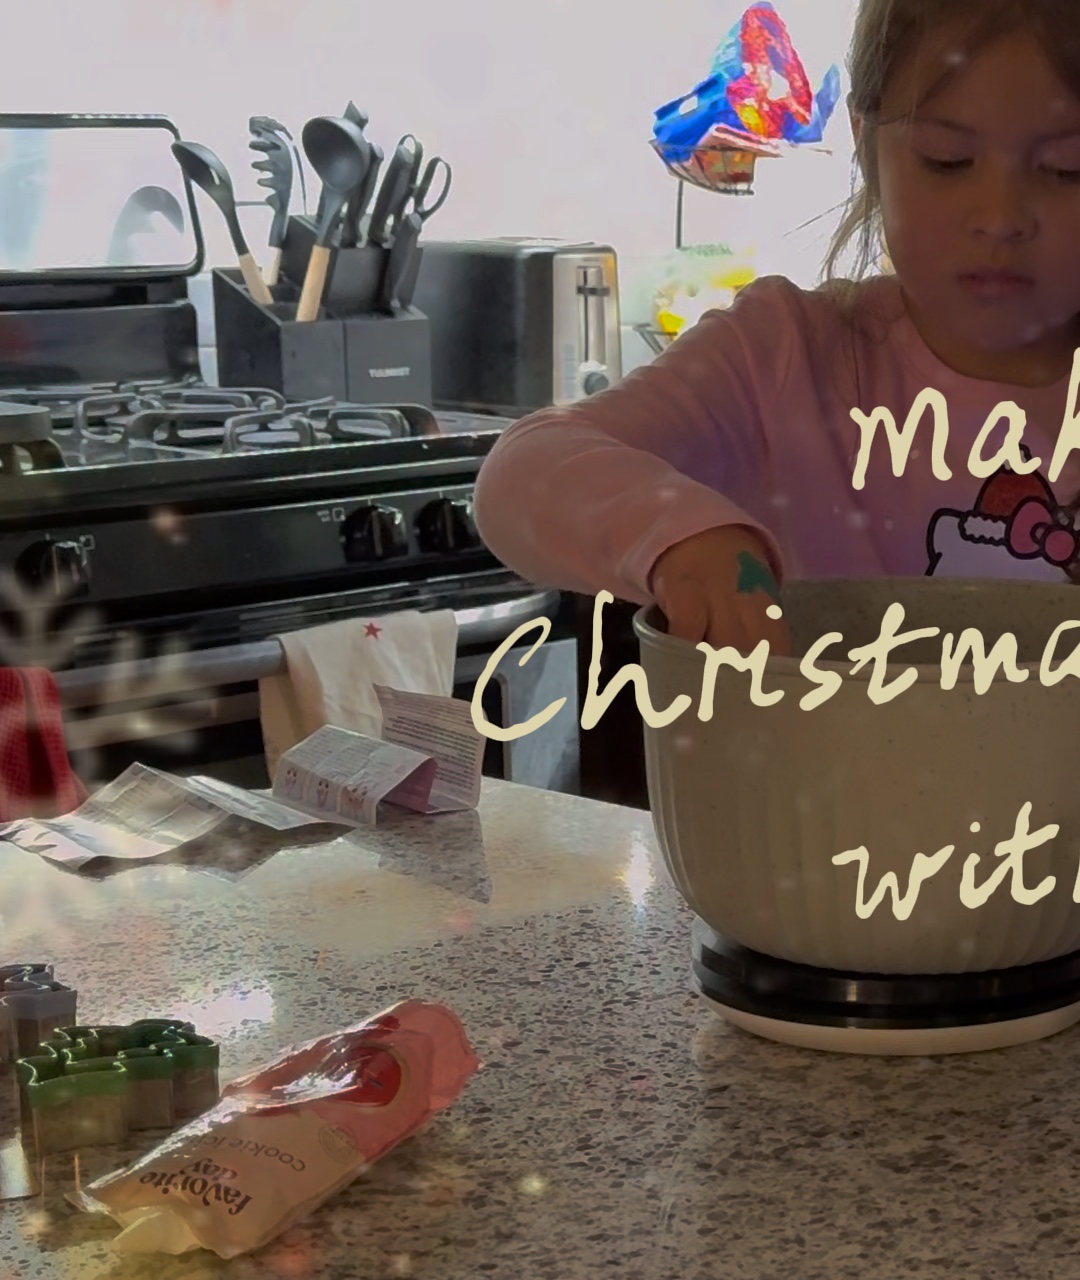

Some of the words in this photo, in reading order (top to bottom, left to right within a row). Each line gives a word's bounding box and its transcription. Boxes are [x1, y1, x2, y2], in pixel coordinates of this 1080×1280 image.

[180, 1157, 239, 1182] day
[228, 1134, 307, 1173] cookie
[139, 1170, 253, 1216] favorite
